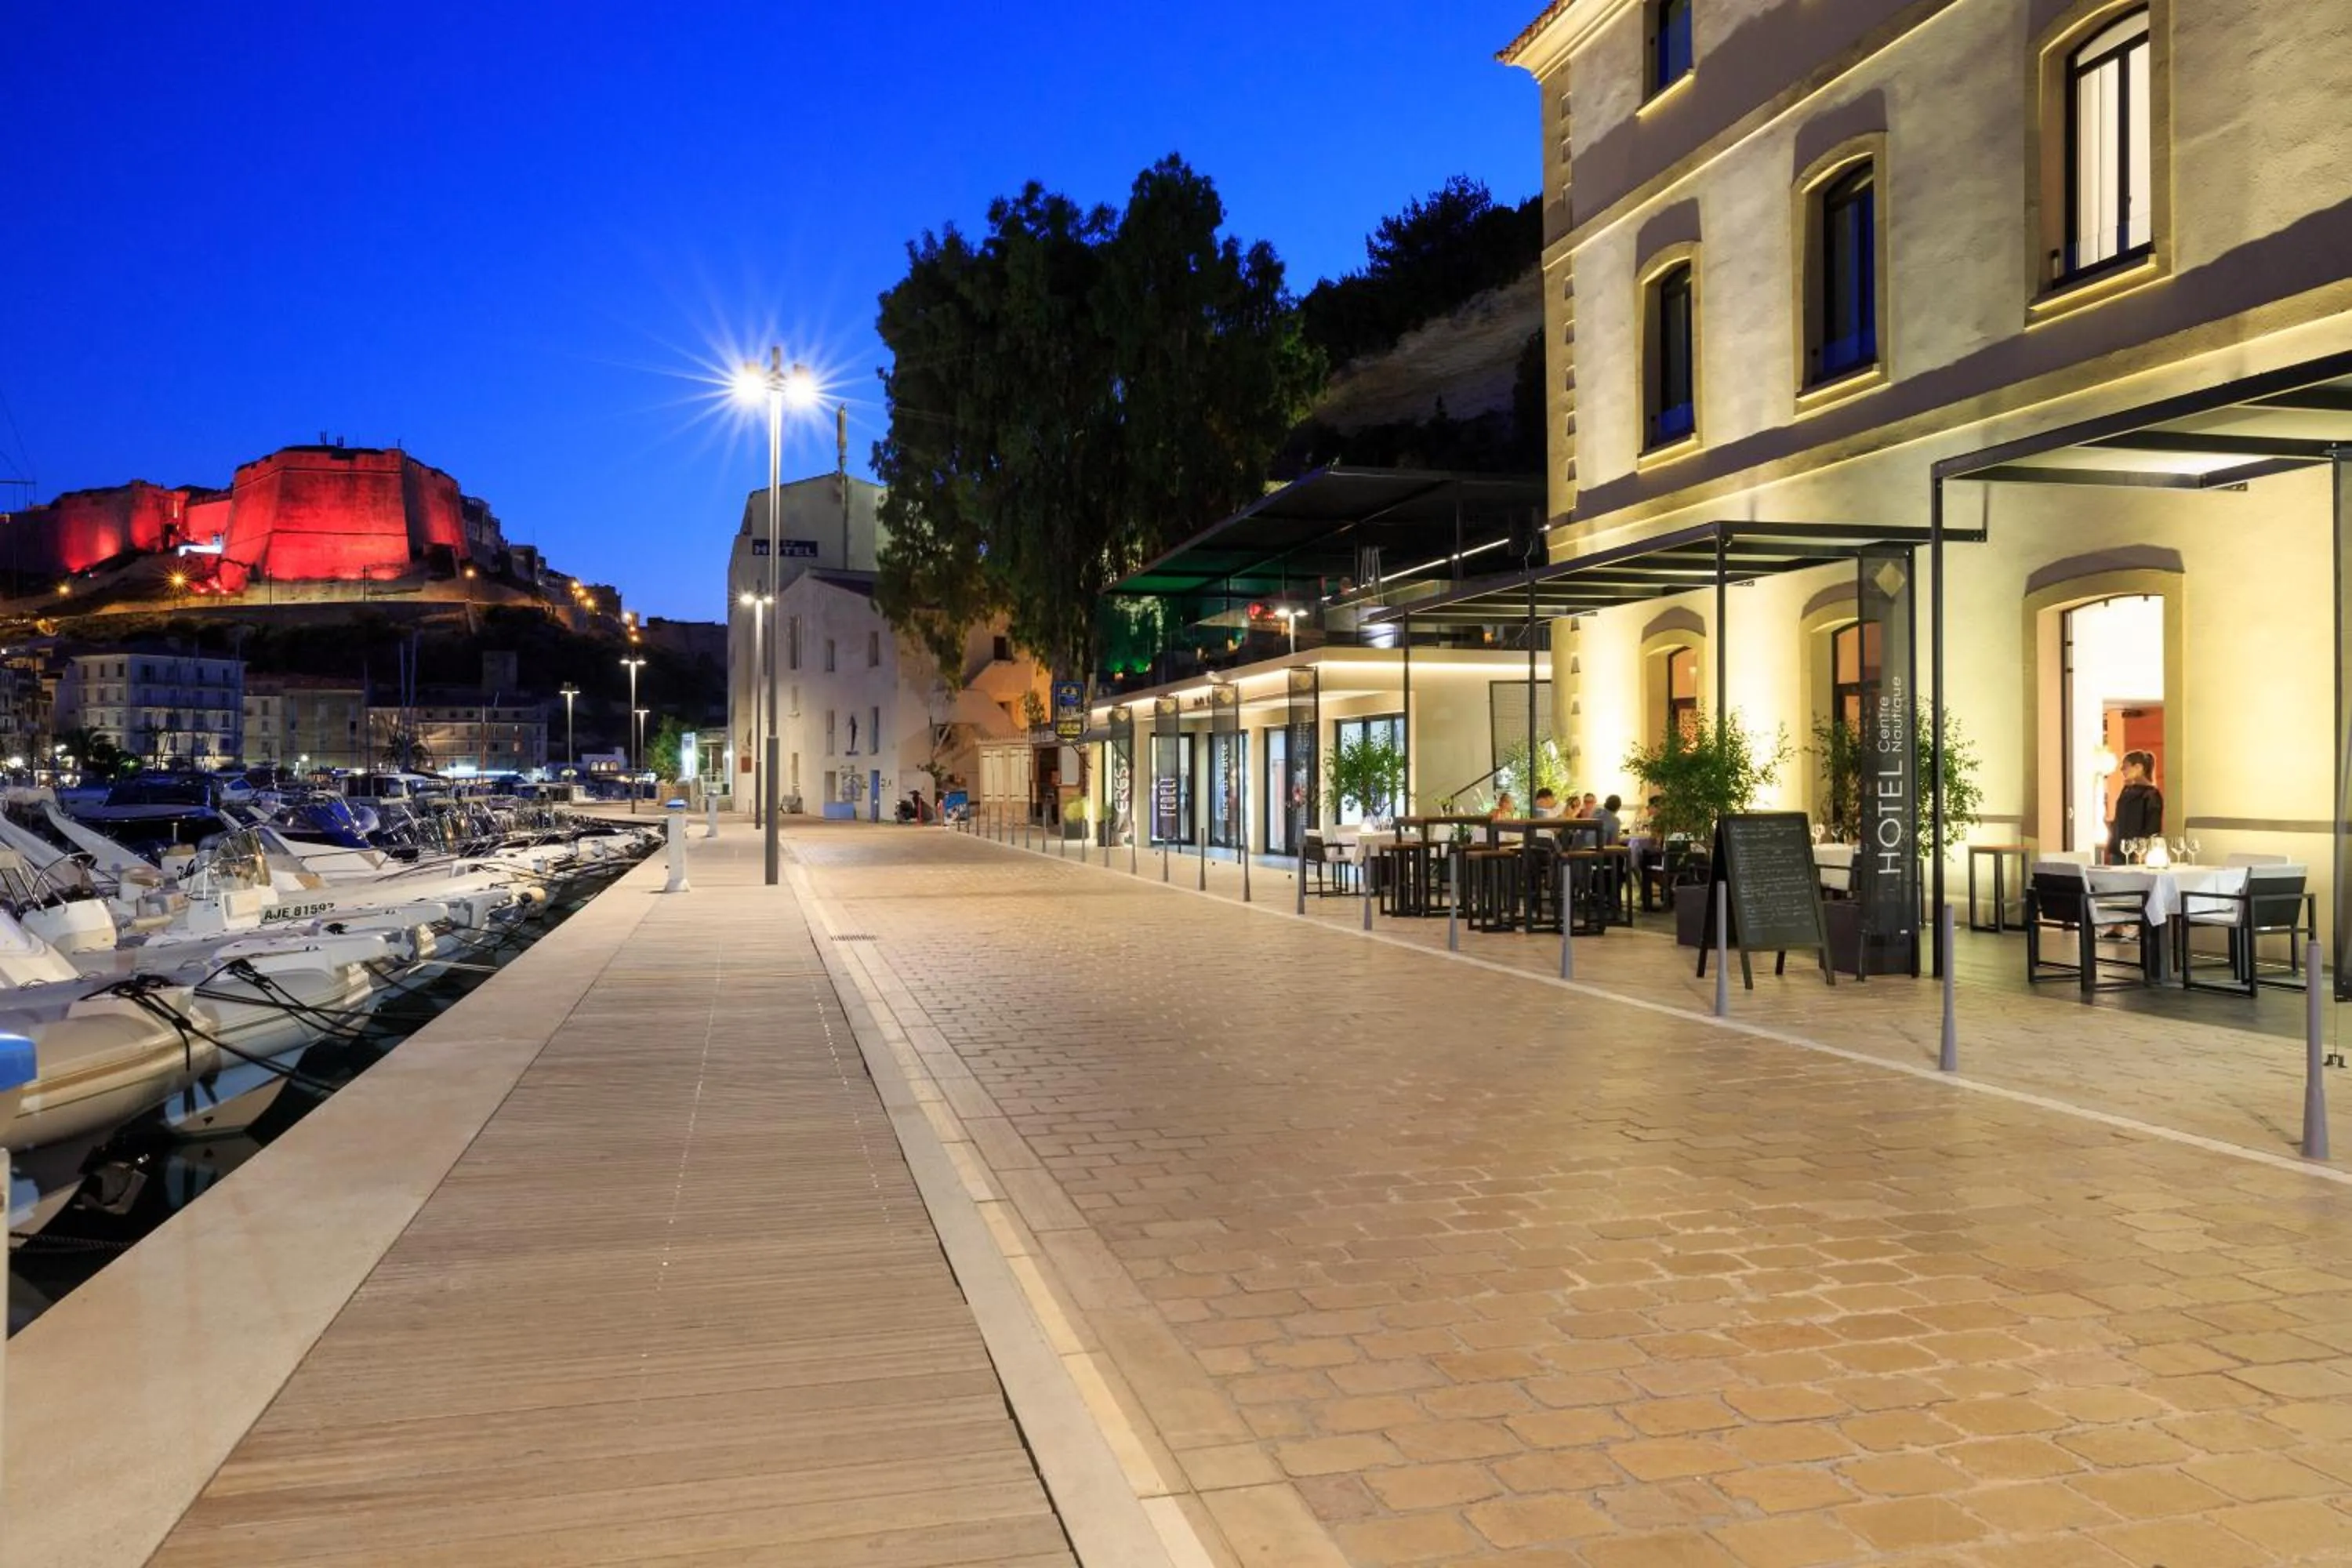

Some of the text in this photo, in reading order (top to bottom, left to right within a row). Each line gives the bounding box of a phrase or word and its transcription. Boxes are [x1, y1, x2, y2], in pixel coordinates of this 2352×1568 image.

[754, 544, 815, 556] HTEL
[1878, 696, 1890, 753] Centre
[1891, 677, 1903, 752] Nautique
[1160, 779, 1176, 815] FEDELI
[1878, 760, 1903, 874] HOTEL
[264, 907, 289, 920] AJE
